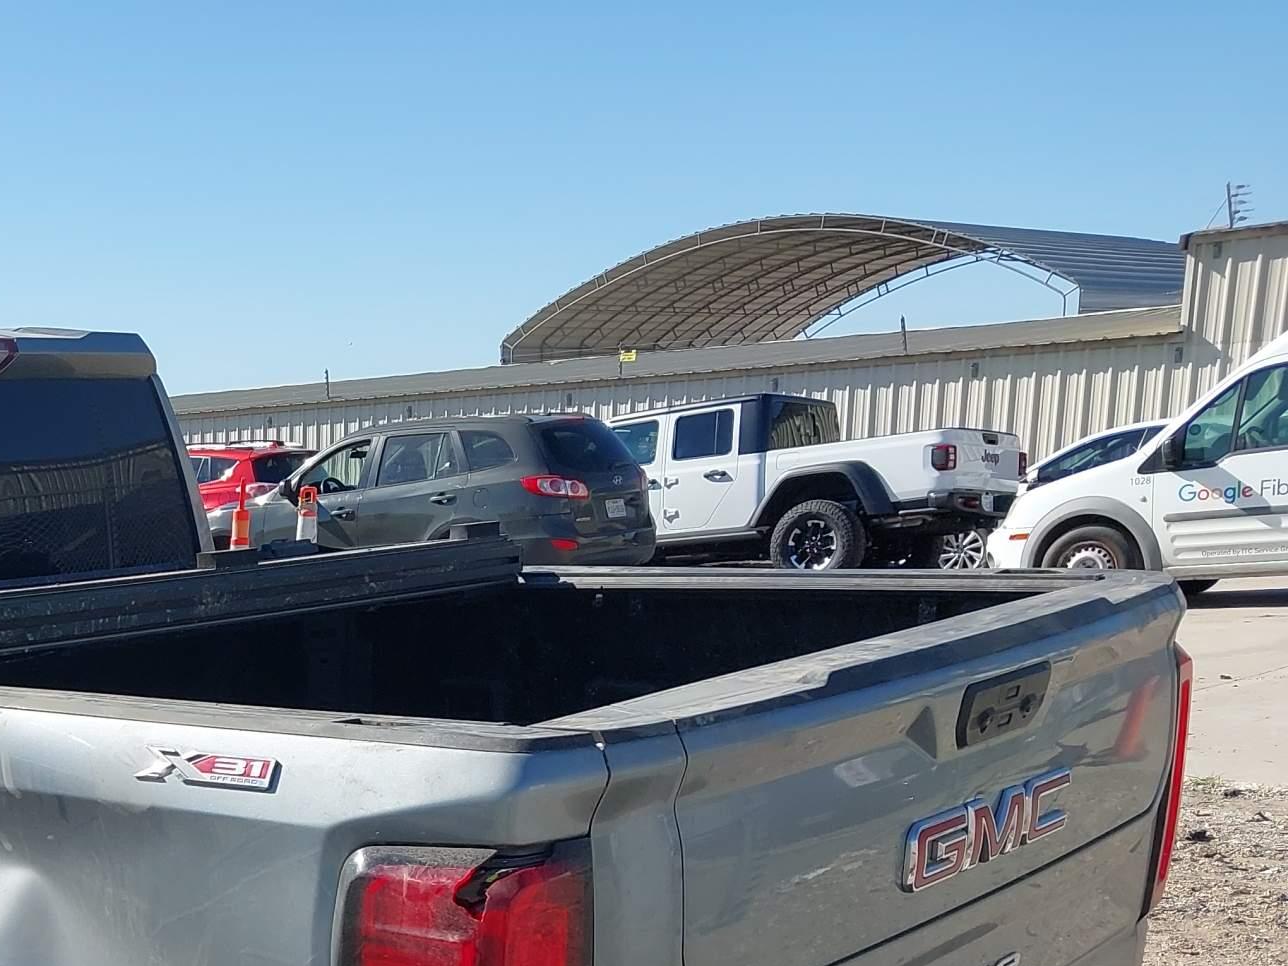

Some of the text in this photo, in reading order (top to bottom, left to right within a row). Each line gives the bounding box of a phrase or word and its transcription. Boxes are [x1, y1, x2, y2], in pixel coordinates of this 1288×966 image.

[981, 449, 1000, 466] Jeep
[1130, 476, 1152, 486] 1028
[1178, 480, 1253, 504] Google
[1201, 549, 1231, 558] Operated
[1254, 545, 1279, 554] Service
[133, 744, 270, 784] X31
[230, 777, 258, 785] ROAD
[903, 768, 1072, 893] GMC
